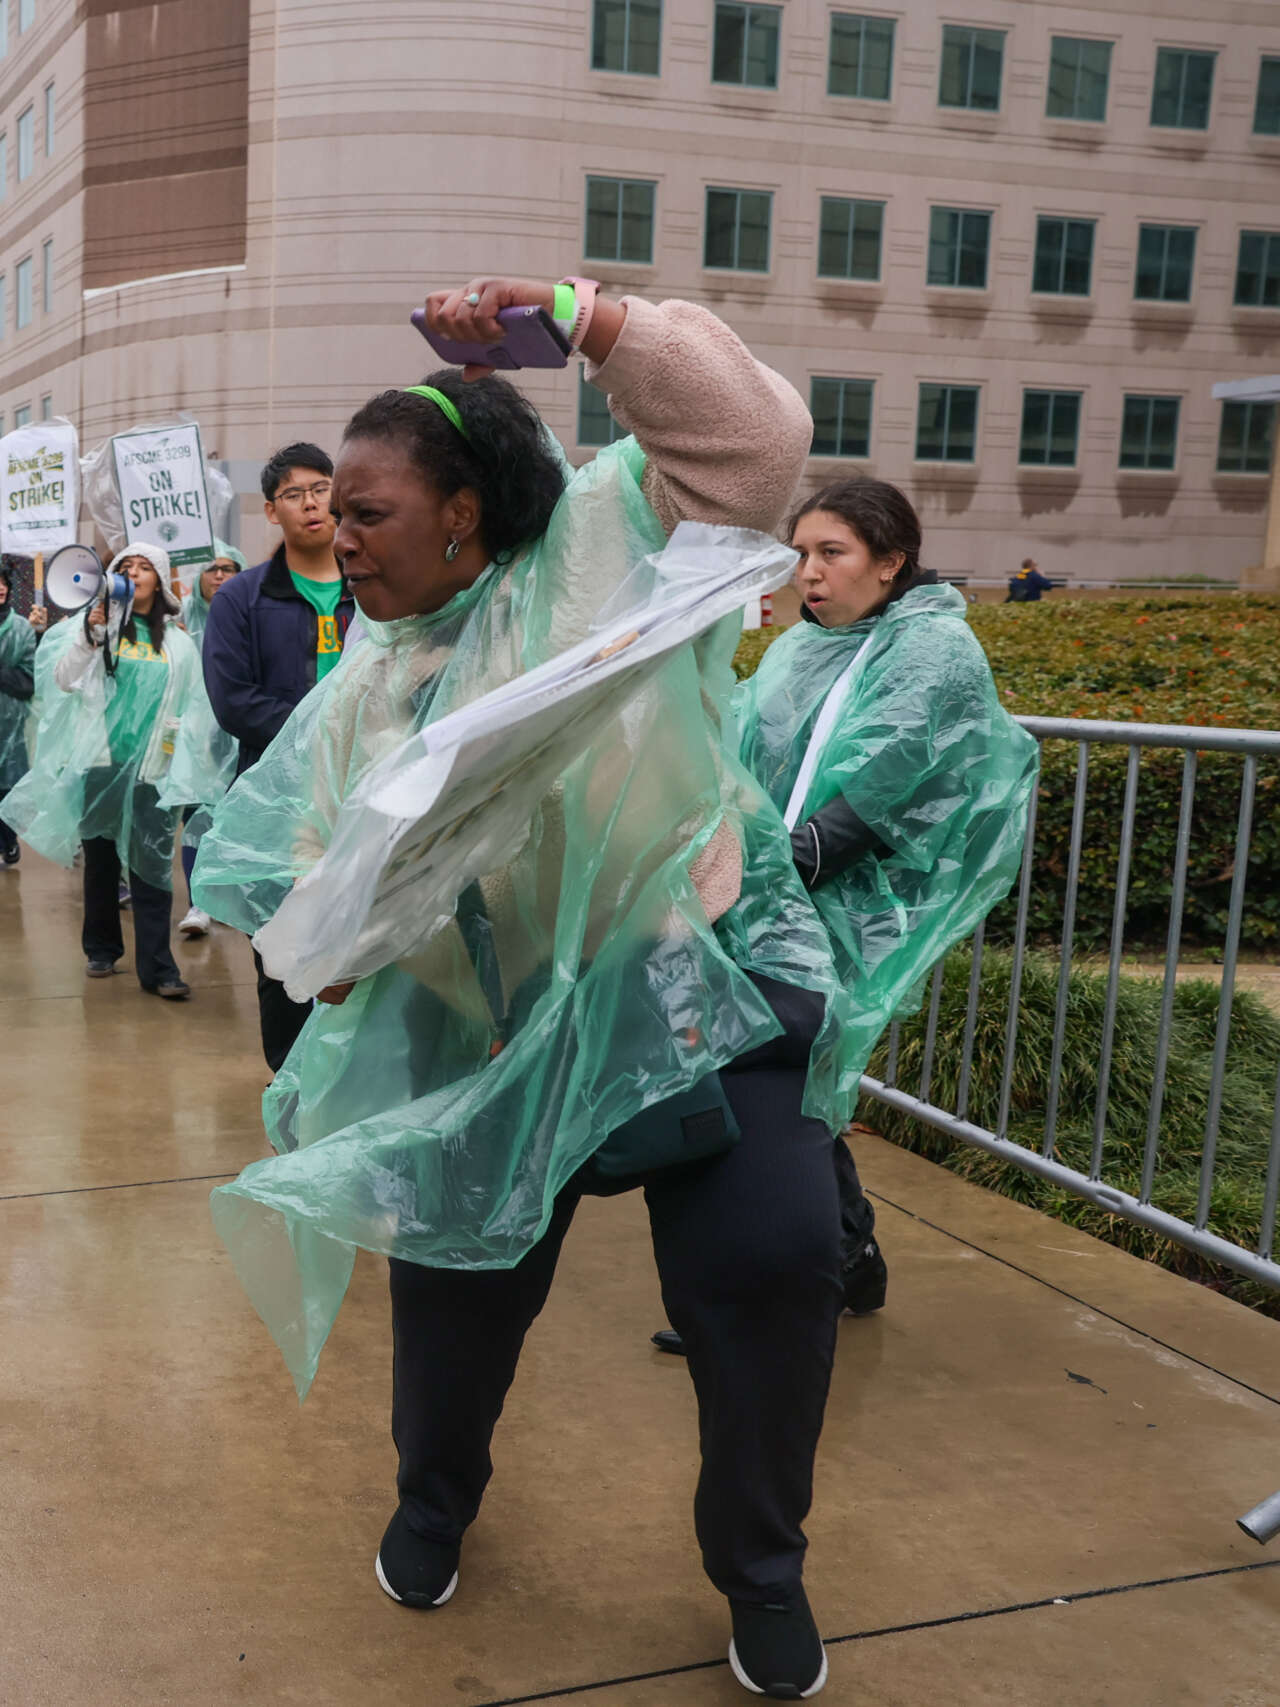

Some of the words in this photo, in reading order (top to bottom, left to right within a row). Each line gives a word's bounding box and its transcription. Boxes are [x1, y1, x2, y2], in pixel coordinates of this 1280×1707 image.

[164, 446, 191, 460] 3299
[149, 470, 173, 492] ON
[9, 480, 64, 511] STRIKE!
[130, 490, 201, 528] STRIKE!
